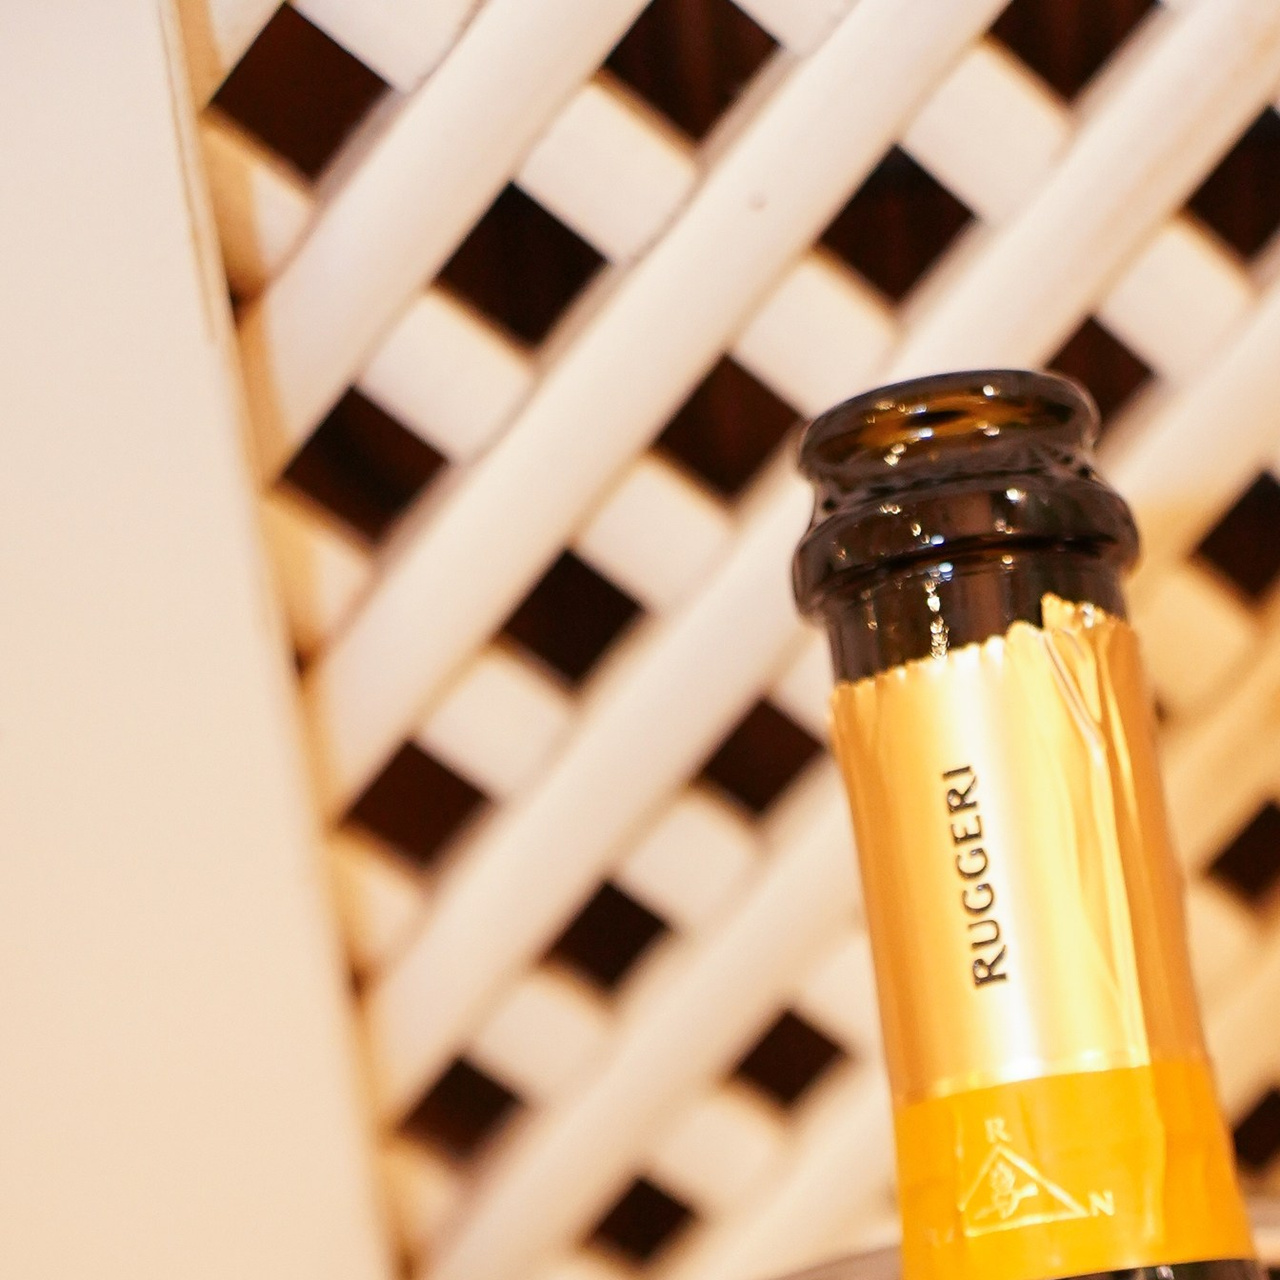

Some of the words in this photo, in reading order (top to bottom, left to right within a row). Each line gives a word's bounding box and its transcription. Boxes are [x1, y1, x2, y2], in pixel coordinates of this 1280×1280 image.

[942, 765, 1008, 988] RUGGERI
[984, 1118, 1011, 1143] R
[1089, 1190, 1115, 1217] N
